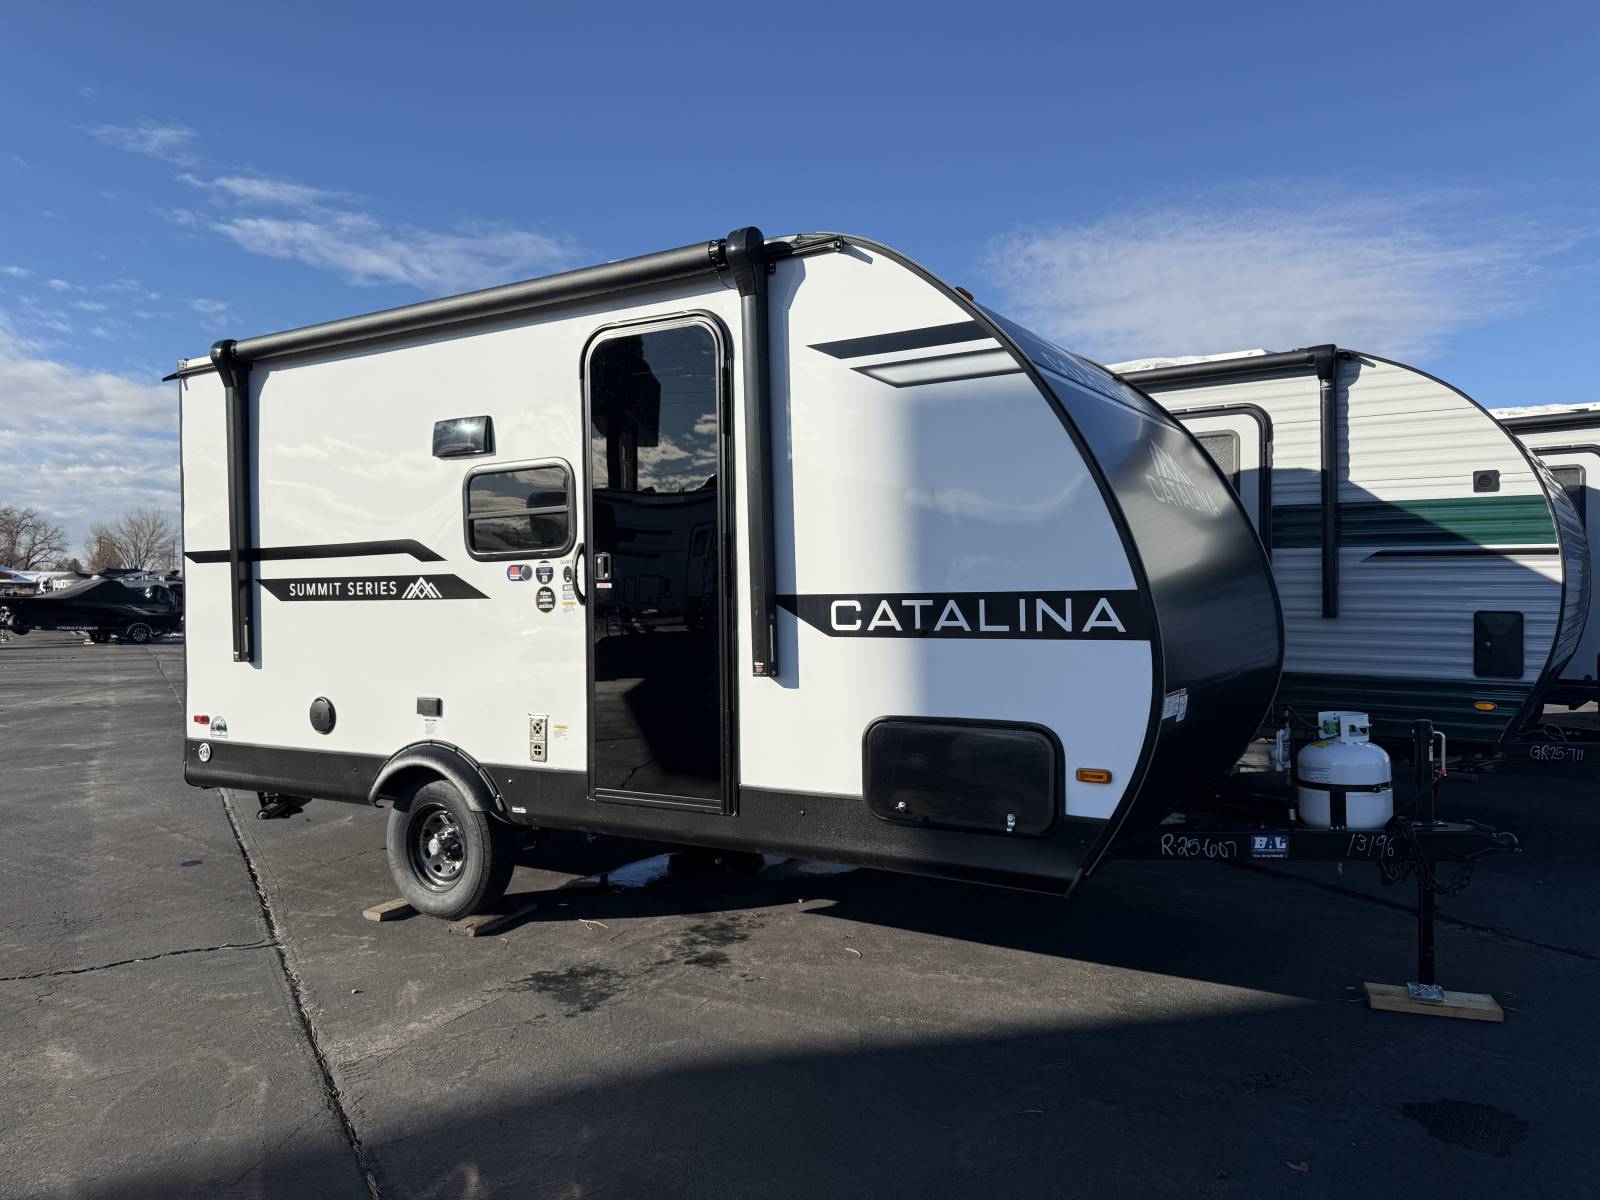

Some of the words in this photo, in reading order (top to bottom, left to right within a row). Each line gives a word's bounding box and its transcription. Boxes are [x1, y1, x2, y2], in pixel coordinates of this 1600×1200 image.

[1144, 473, 1222, 516] CATALINA
[289, 582, 342, 597] SUMMIT
[347, 581, 398, 596] SERIES
[830, 597, 1127, 633] CATALINA
